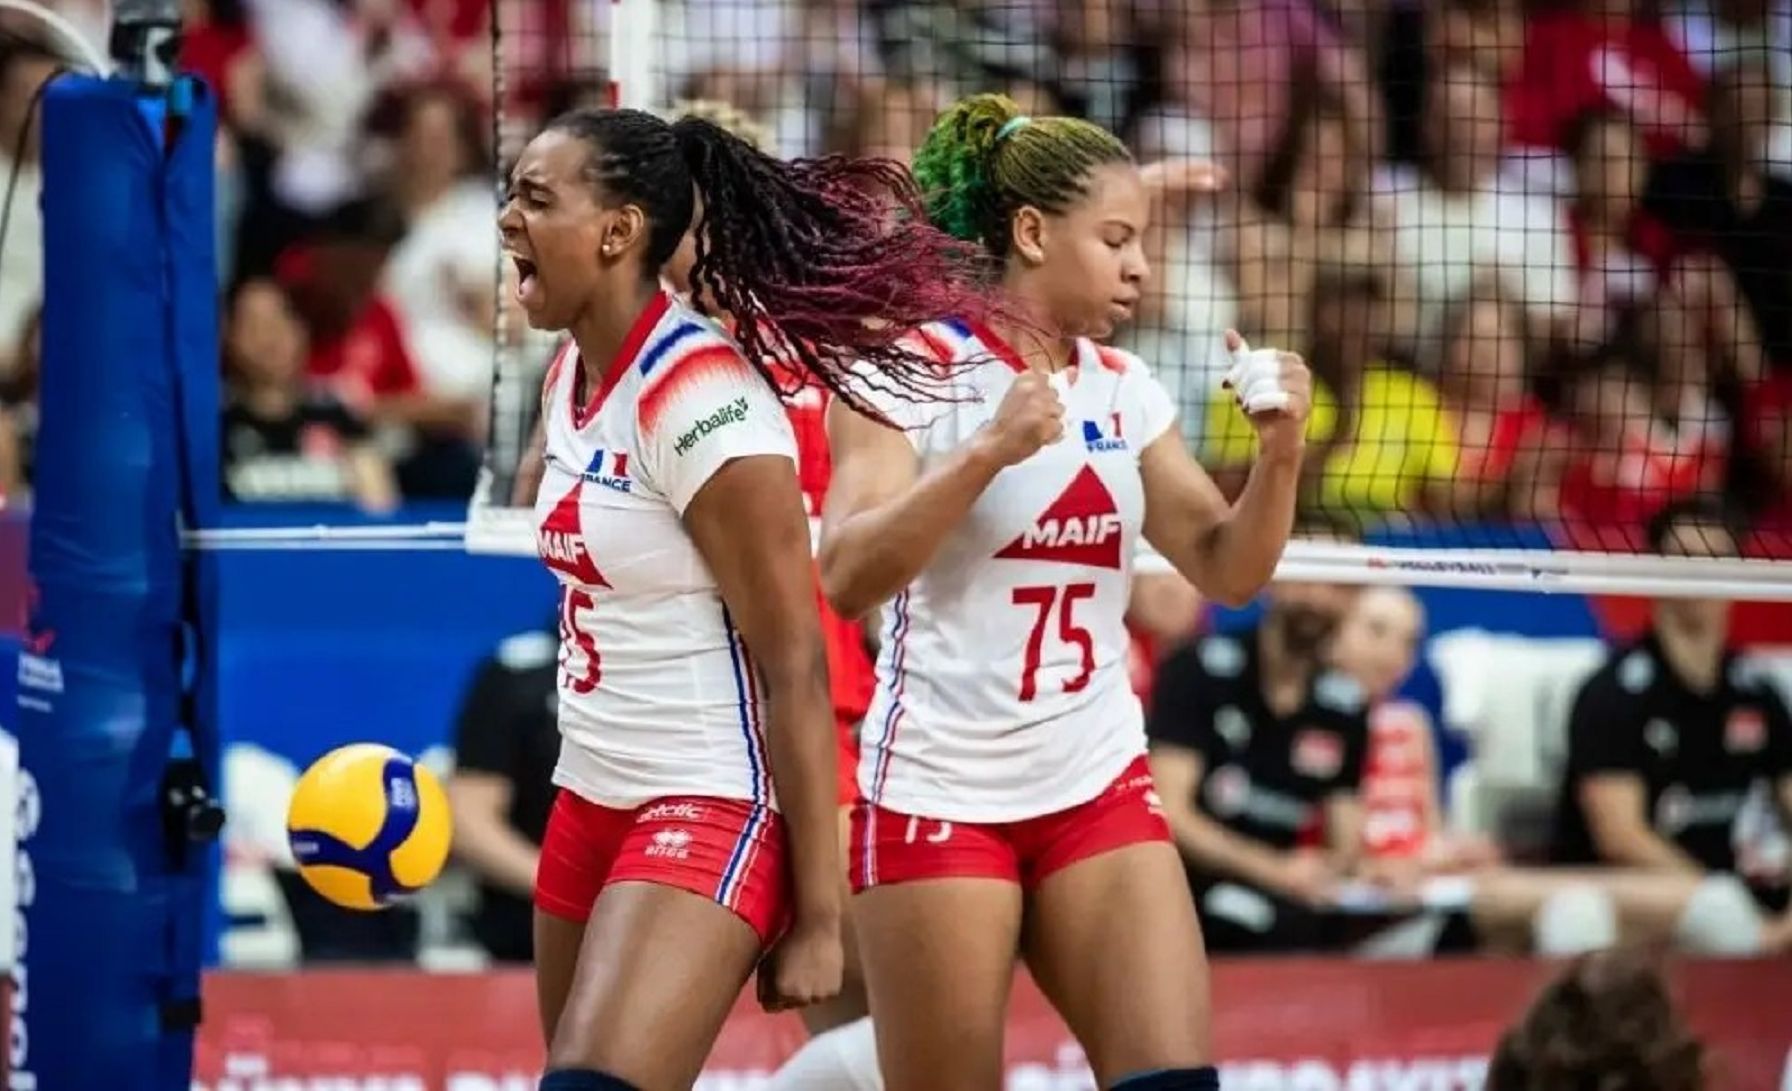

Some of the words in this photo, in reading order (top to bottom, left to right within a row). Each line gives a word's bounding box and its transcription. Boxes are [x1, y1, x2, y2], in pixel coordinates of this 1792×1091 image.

[673, 404, 746, 457] Herbalife
[538, 531, 585, 565] MAIF
[1022, 512, 1120, 549] MAIF
[1012, 583, 1095, 701] 75
